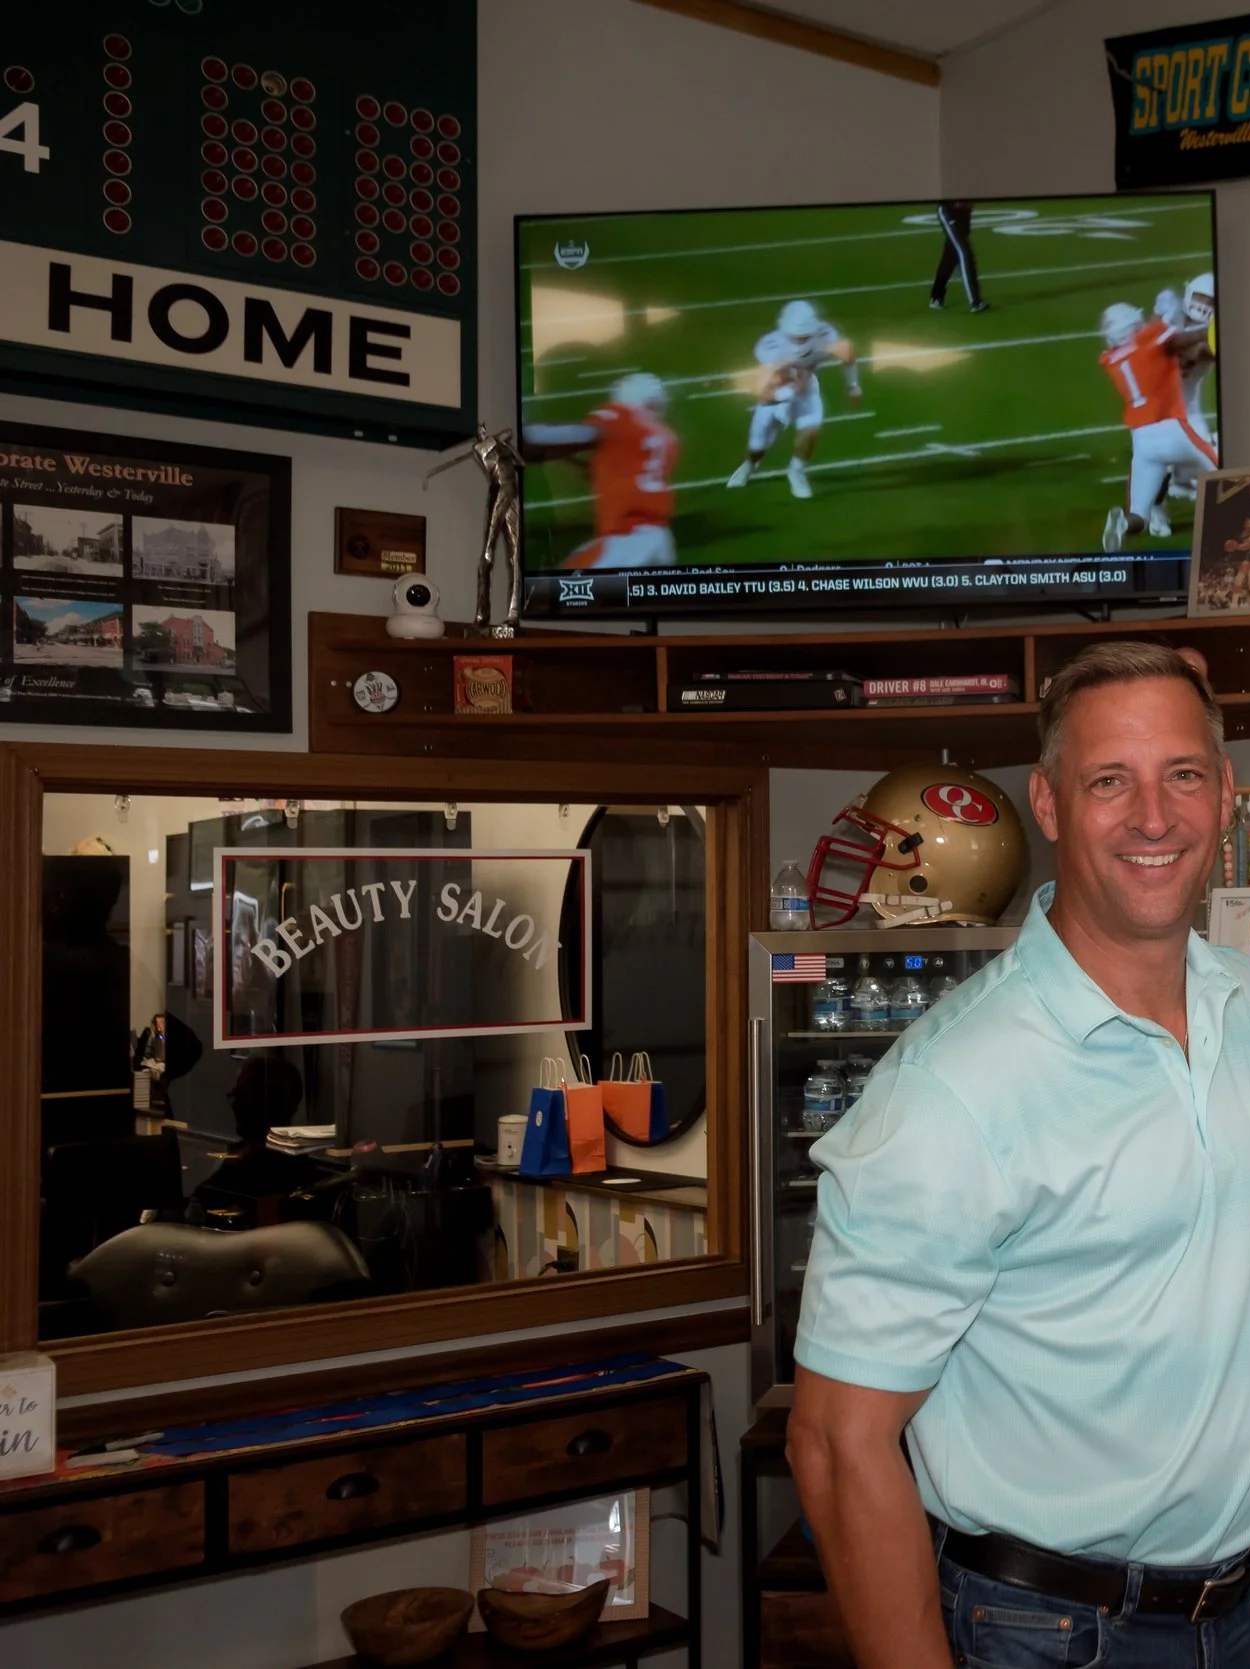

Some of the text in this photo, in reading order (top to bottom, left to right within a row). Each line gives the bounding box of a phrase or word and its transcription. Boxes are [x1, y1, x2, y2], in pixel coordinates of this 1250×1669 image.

[1133, 42, 1230, 129] SPORT
[0, 101, 51, 174] 4
[48, 261, 412, 388] HOME
[1120, 359, 1147, 409] 1
[62, 453, 195, 488] Westerville
[12, 477, 44, 492] Street
[124, 488, 154, 505] Today
[647, 584, 658, 597] 3.
[660, 583, 697, 596] DAVID
[700, 581, 741, 595] BAILEY
[743, 580, 766, 593] TTU
[768, 579, 795, 593] (3.5)
[798, 579, 809, 591] 4.
[811, 578, 850, 591] CHASE
[852, 577, 900, 590] WILSON
[902, 576, 929, 588] WVU
[931, 574, 959, 588] (3.0)
[961, 575, 972, 586] 5.
[975, 573, 1027, 586] CLAYTON
[1030, 571, 1070, 584] SMITH
[1072, 570, 1096, 583] ASU
[1098, 569, 1127, 583] (3.0)
[4, 675, 76, 689] of Excellence
[869, 680, 909, 694] DRIVER
[912, 679, 927, 693] #8
[930, 680, 944, 688] DALE
[251, 880, 562, 979] BEAUTY SALON
[19, 1397, 38, 1415] to
